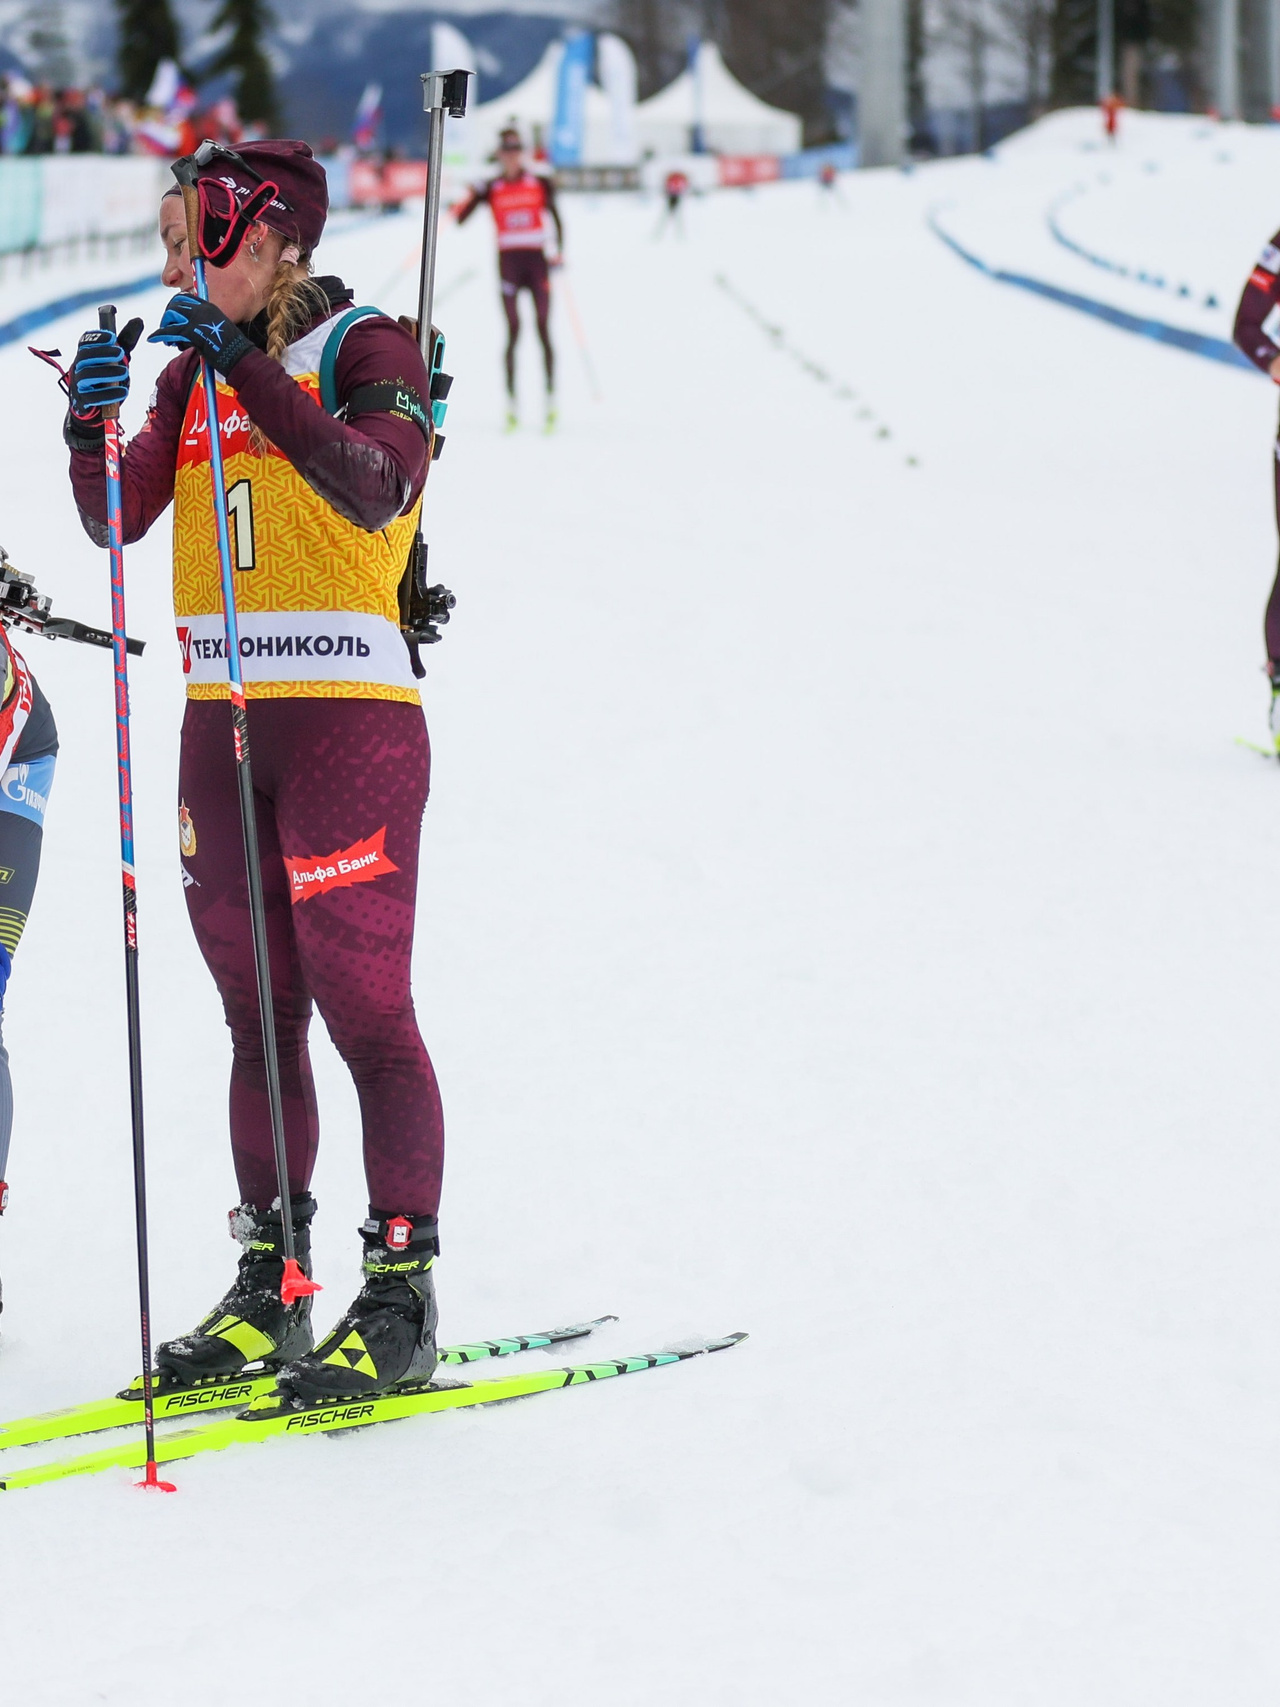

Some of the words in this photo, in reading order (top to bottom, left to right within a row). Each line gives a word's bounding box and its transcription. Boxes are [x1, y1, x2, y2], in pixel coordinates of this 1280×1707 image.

[193, 327, 221, 353] ELITE
[189, 410, 252, 439] Алфа
[226, 479, 256, 571] 1
[192, 635, 371, 660] ТЕХОНИКОЛЬ
[292, 863, 337, 885] Альфа
[337, 850, 380, 875] Банк
[364, 1260, 420, 1273] CHER
[165, 1384, 253, 1411] FISCHER
[286, 1405, 375, 1431] FISCHER
